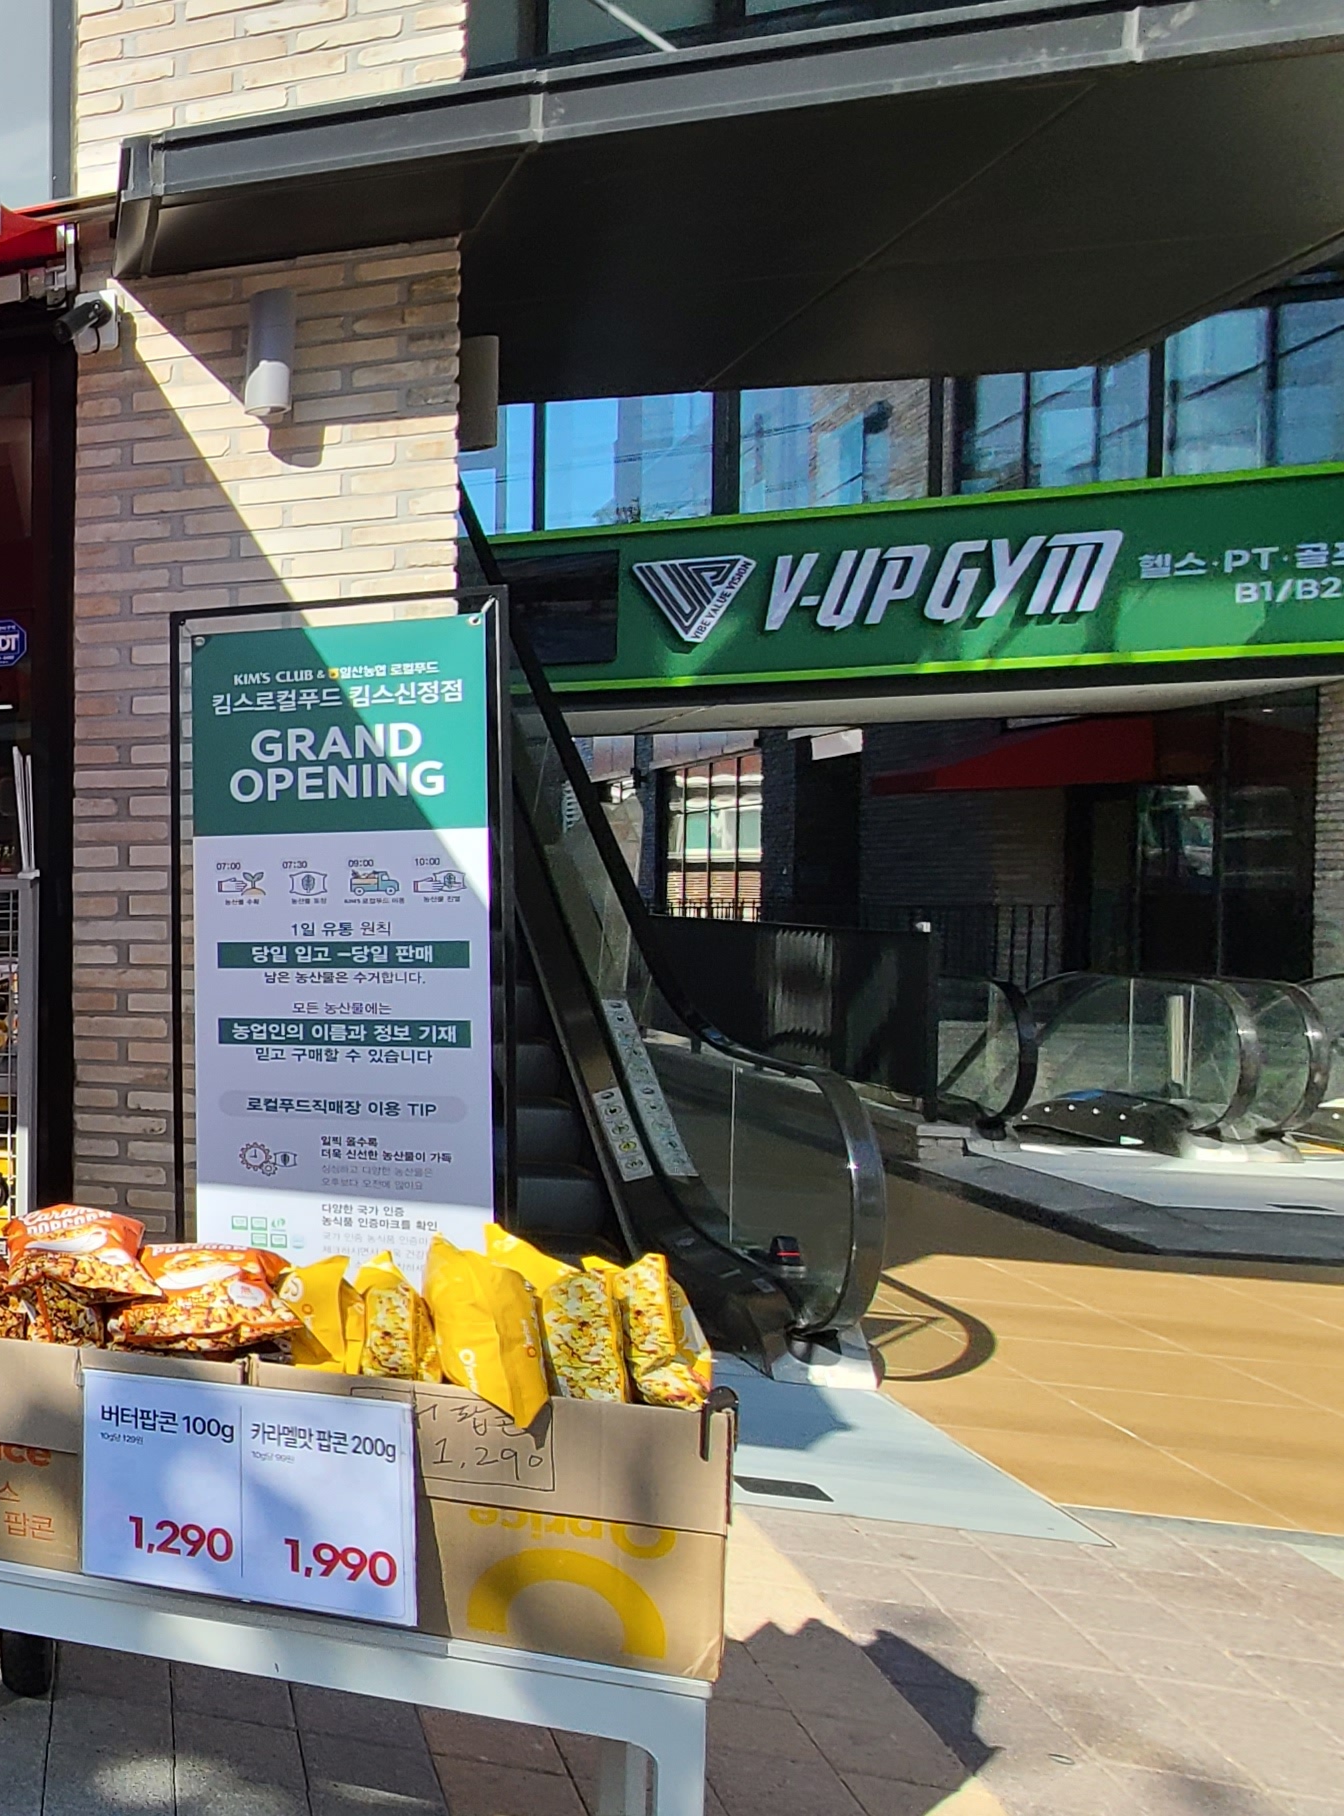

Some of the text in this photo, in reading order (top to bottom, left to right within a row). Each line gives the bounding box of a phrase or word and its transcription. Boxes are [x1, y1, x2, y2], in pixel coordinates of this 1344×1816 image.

[924, 530, 1124, 625] GYM
[691, 560, 753, 640] VIBE VALUE VISION
[1235, 576, 1343, 604] B1/B2
[234, 671, 270, 686] KIM'S
[275, 669, 313, 684] CLUB
[317, 670, 325, 680] &
[390, 661, 441, 676] 로컬푸드
[212, 679, 463, 716] 킴스로컬푸드 킴스신정점
[251, 722, 423, 763] GRAND
[230, 760, 446, 804] OPENING
[216, 862, 241, 871] 07:00
[282, 860, 308, 869] 07:30
[348, 859, 374, 868] 09:00
[415, 857, 441, 867] 10:00
[291, 921, 392, 937] 1일 유통 원칙
[251, 945, 288, 964] 당일
[295, 945, 331, 963] 입고
[395, 945, 434, 964] 판매
[264, 971, 427, 986] 남은 농산물은 수거합니다.
[292, 1001, 392, 1015] 모든 농산물에는
[232, 1022, 457, 1044] 농업인의 이름과 정보 기재
[255, 1047, 433, 1065] 믿고 구매할 수 있습니다
[246, 1097, 437, 1118] 로컬푸드직매장 이용 TIP
[321, 1135, 378, 1148] 일찍 올수록
[321, 1148, 452, 1163] 더욱 신선한 농산물이 가득
[362, 1165, 391, 1176] 다양한
[321, 1203, 405, 1217] 다양한 국가 인증
[321, 1215, 438, 1232] 농식품 인증마크를 확인
[101, 1405, 235, 1444] 버터팝콘 100g
[251, 1422, 397, 1464] 카라멜맛 팝콘 200g
[432, 1437, 544, 1481] 1,290
[4, 1510, 55, 1541] 팝콘
[129, 1515, 234, 1562] 1,290
[284, 1538, 397, 1588] 1,990
